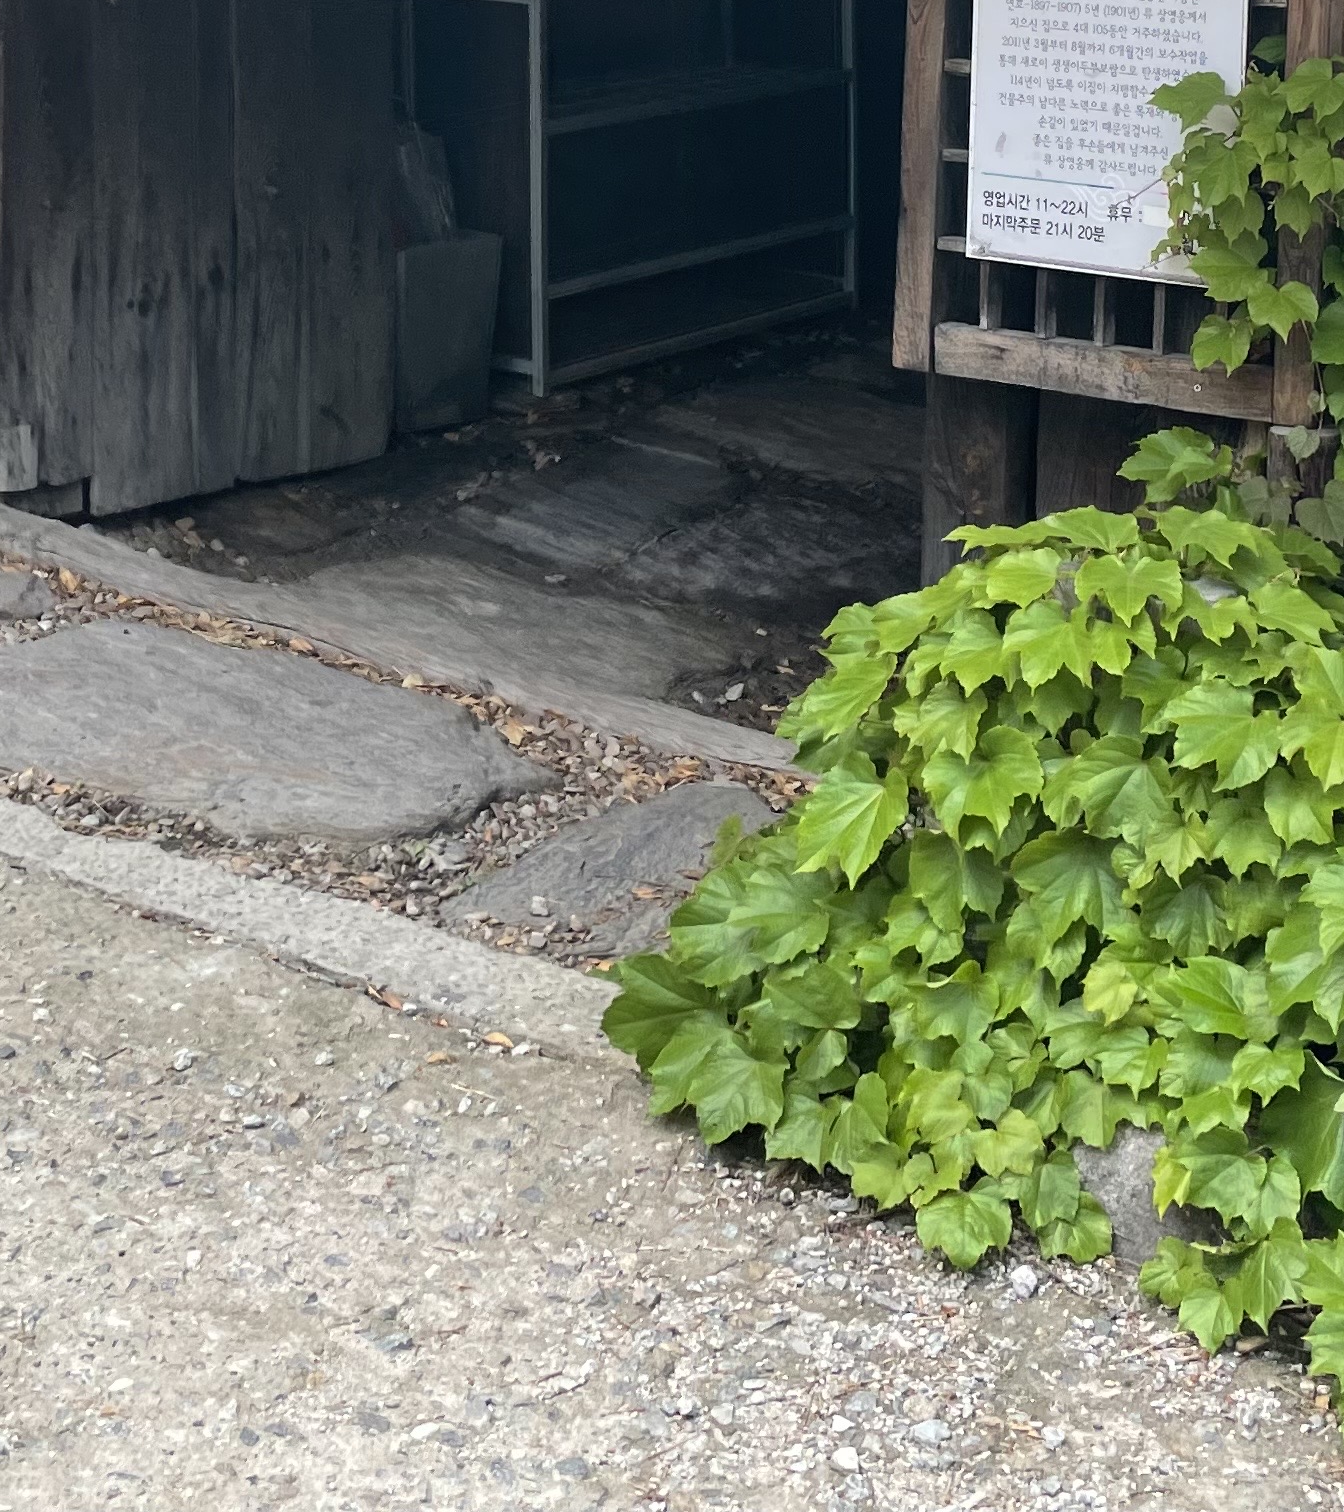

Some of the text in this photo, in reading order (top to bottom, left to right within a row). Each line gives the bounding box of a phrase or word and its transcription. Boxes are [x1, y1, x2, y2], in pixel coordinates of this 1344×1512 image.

[1010, 17, 1037, 32] 지으신
[983, 190, 1031, 211] 영업시간
[1036, 197, 1088, 218] 11~22시
[982, 213, 1105, 243] 마지막주문 21시 20분
